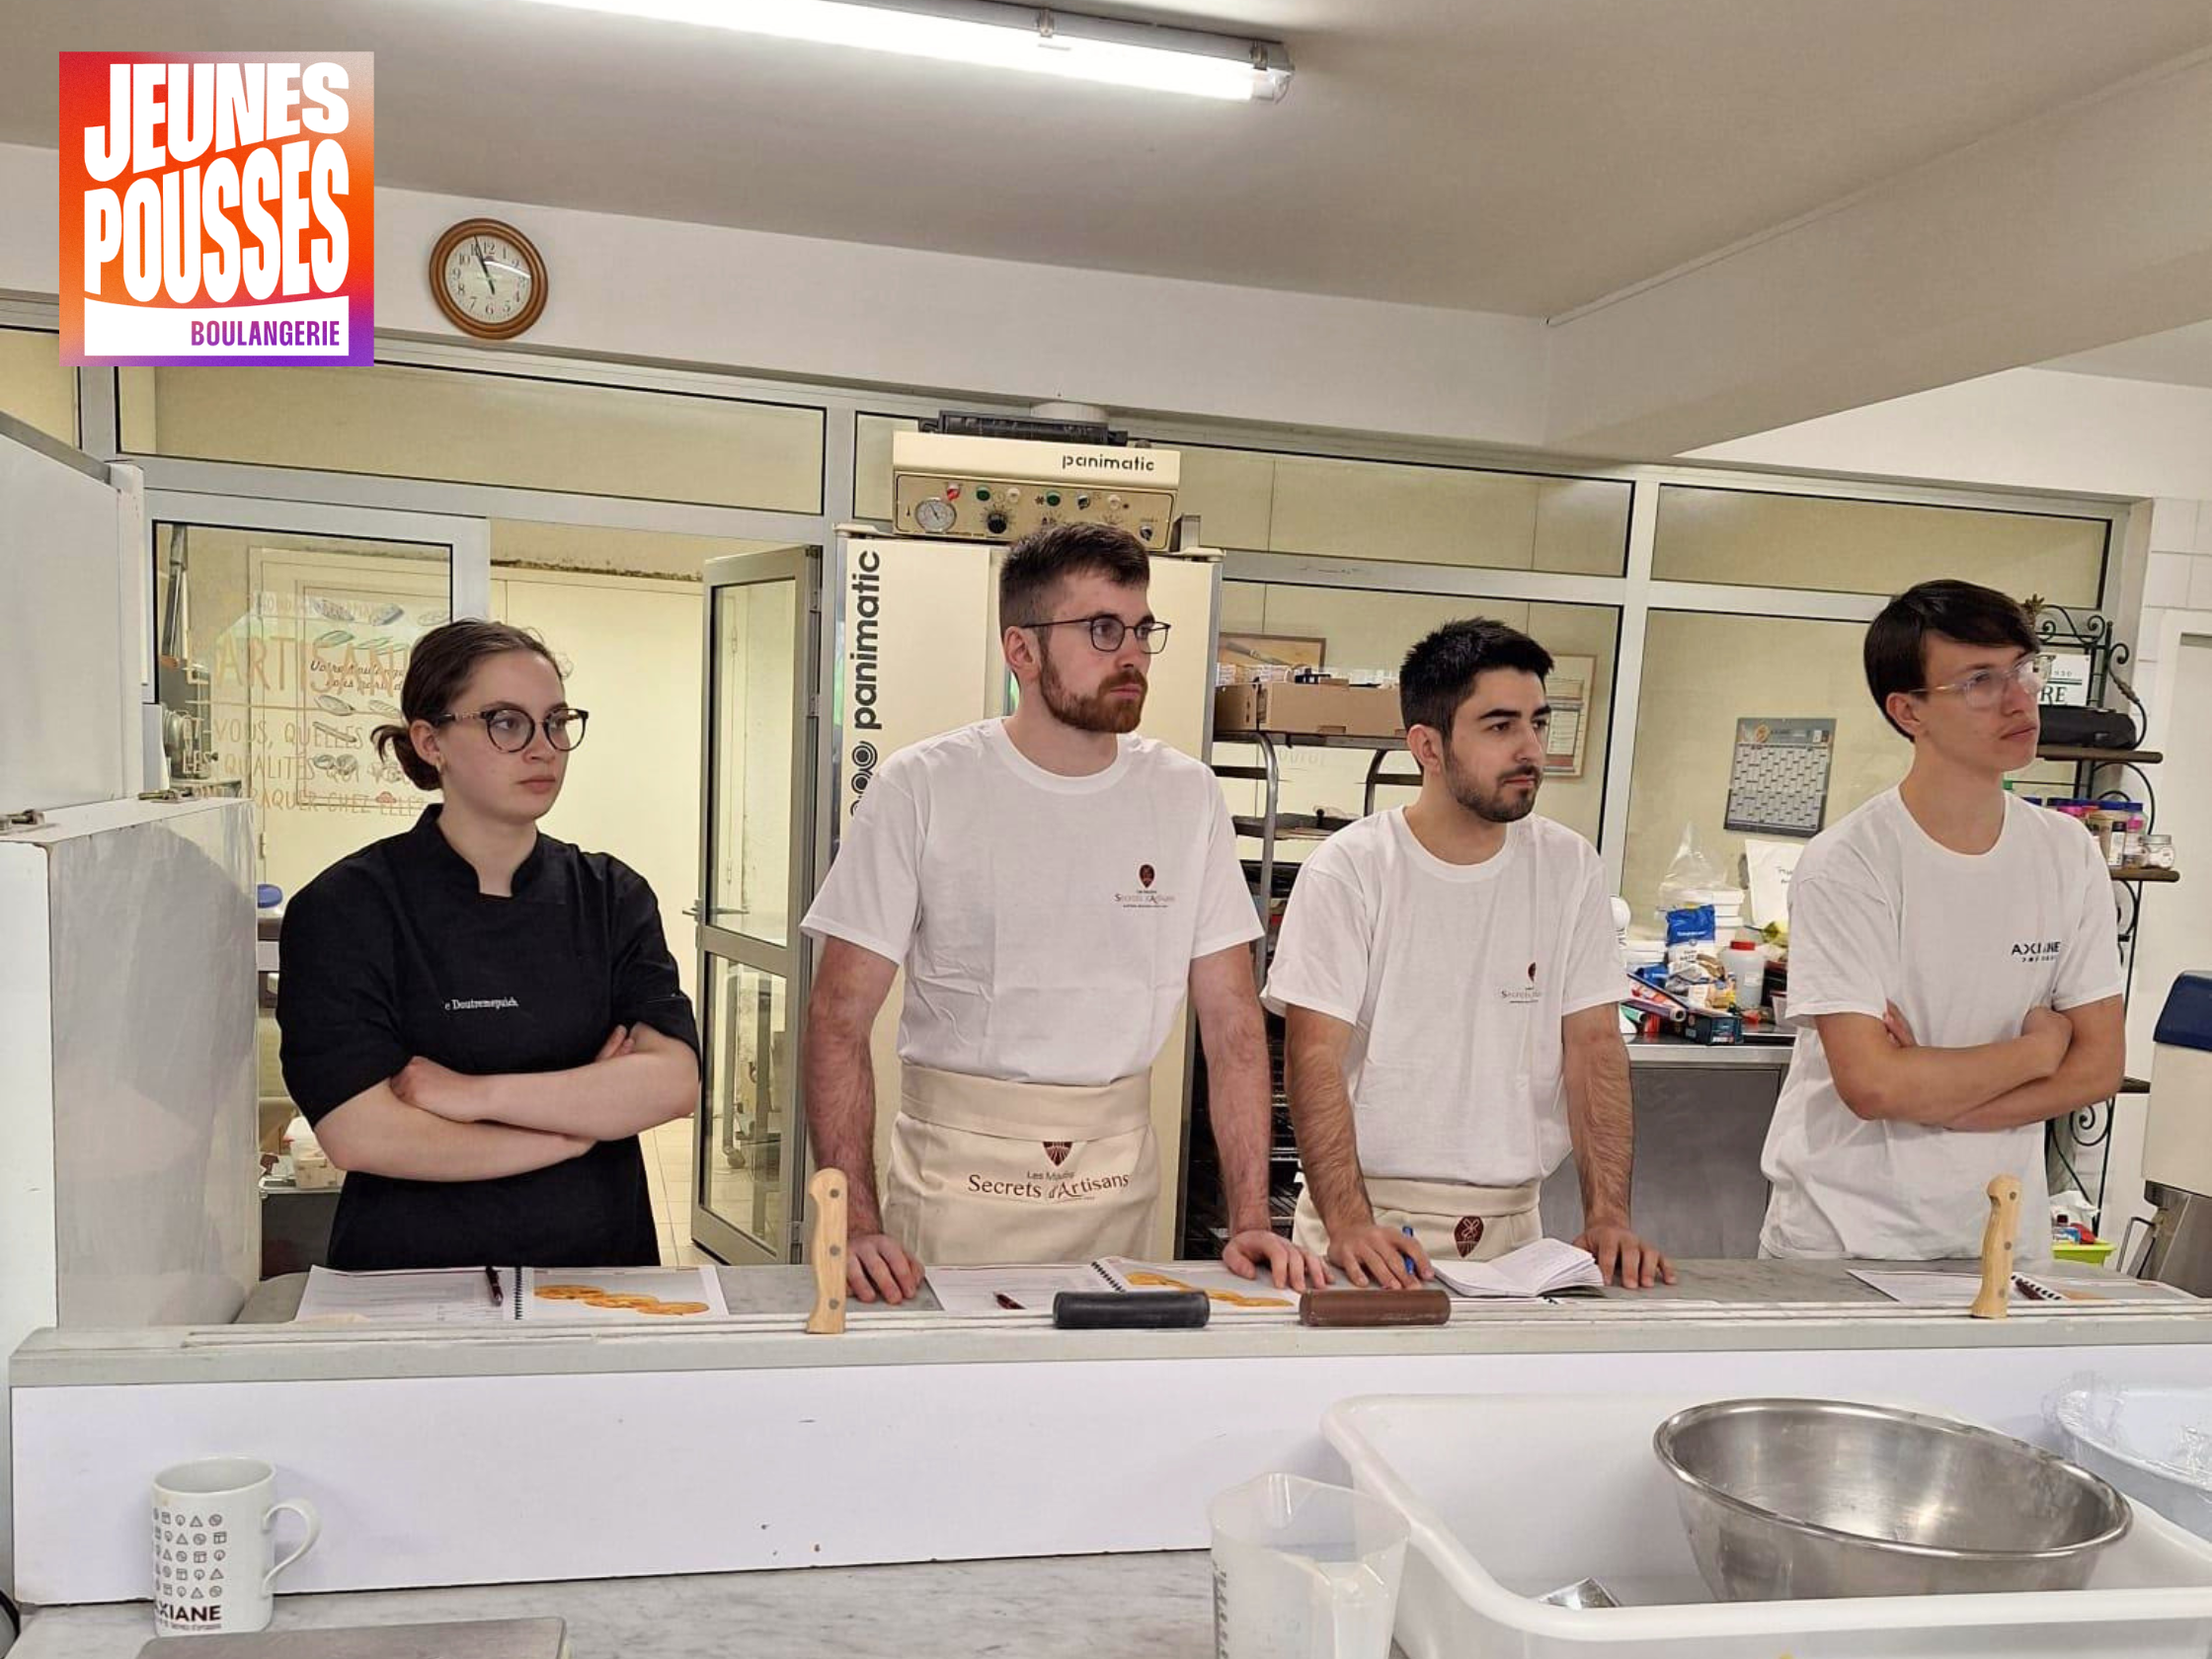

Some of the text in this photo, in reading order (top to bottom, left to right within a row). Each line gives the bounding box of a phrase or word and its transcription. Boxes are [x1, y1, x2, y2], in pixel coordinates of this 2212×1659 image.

[483, 241, 495, 255] 12
[1063, 453, 1154, 471] panimatic
[849, 550, 883, 730] panimatic
[968, 1174, 1042, 1199] Secrets
